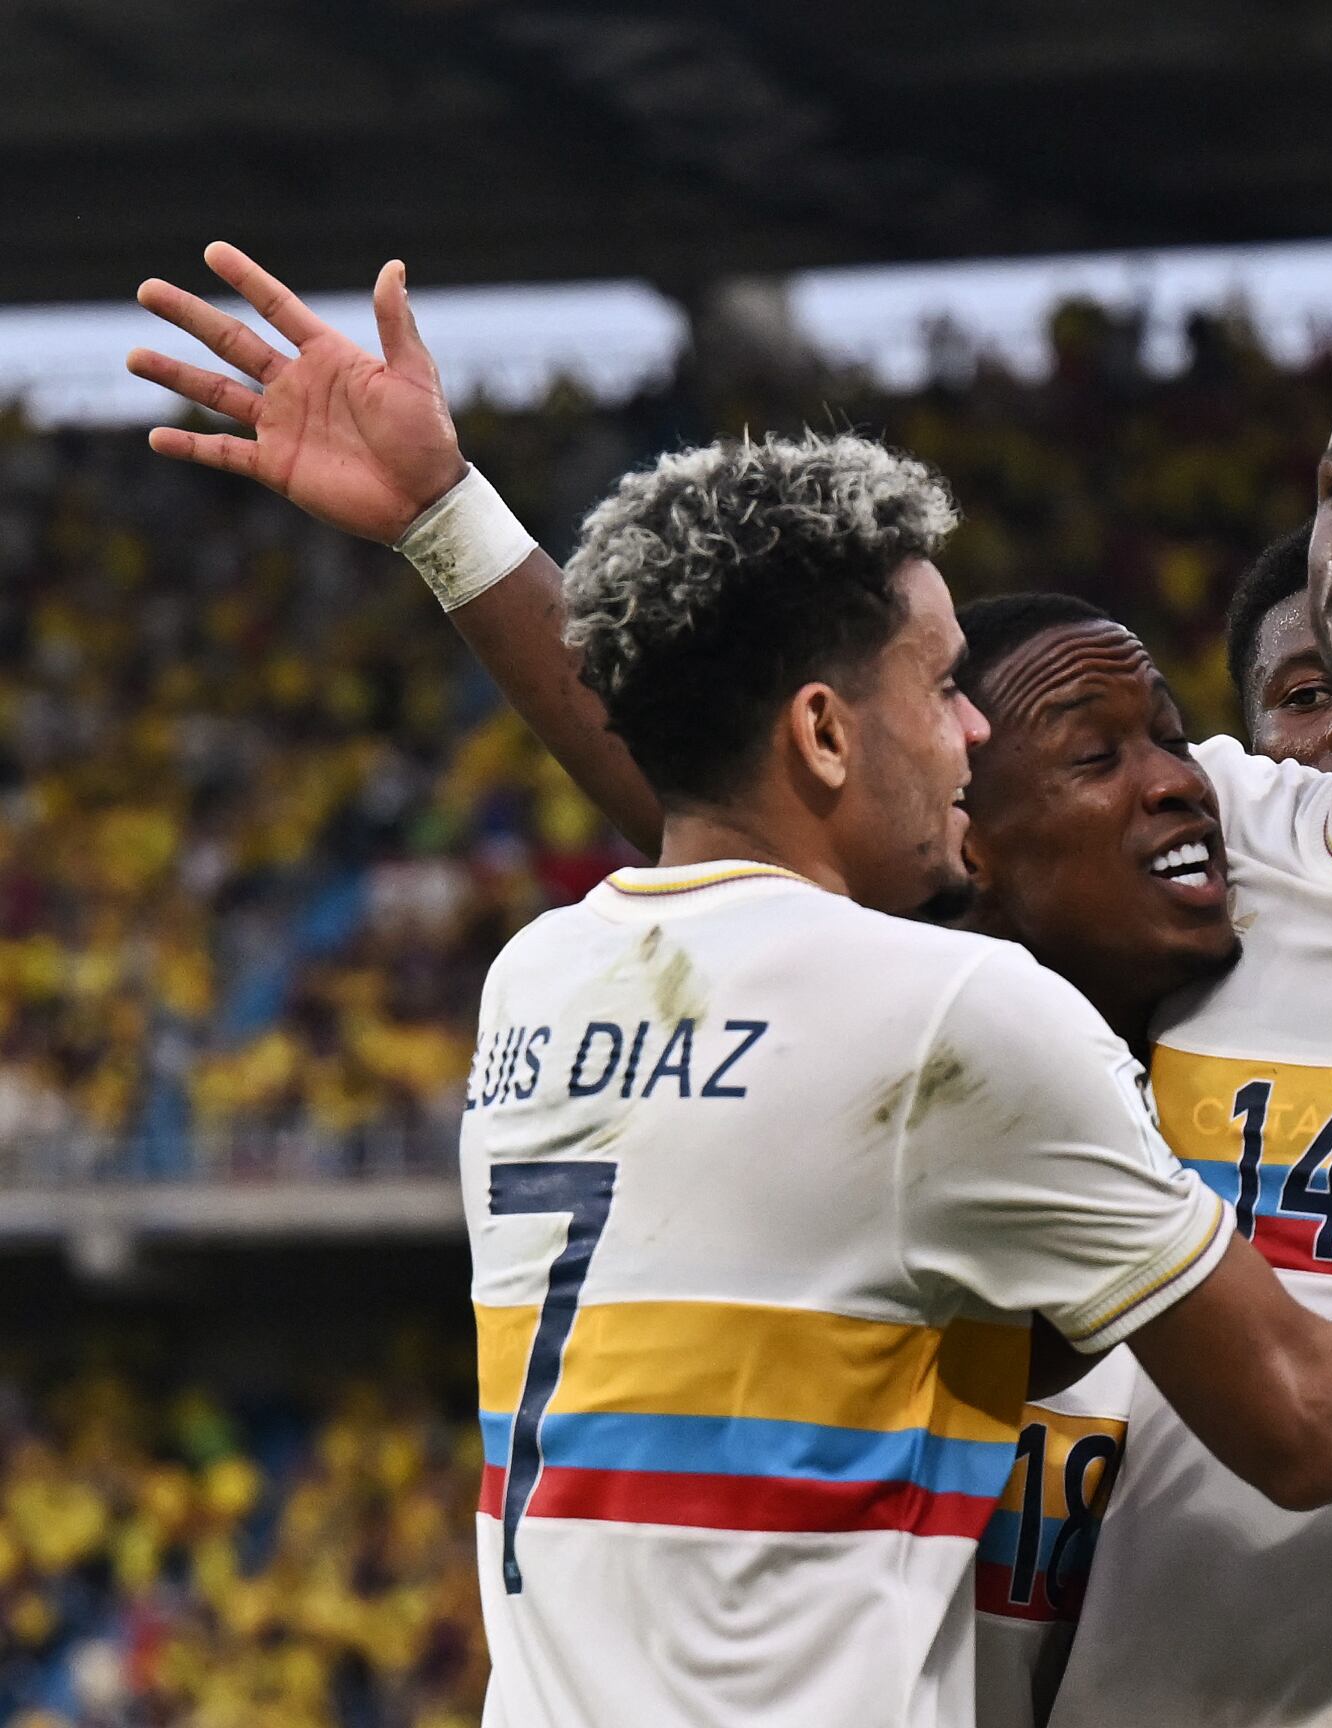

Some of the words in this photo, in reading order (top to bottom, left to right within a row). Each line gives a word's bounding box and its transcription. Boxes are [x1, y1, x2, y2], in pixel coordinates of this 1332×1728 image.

[568, 1018, 770, 1099] DIAZ
[488, 1160, 619, 1595] 7
[1008, 1420, 1119, 1611] 18
